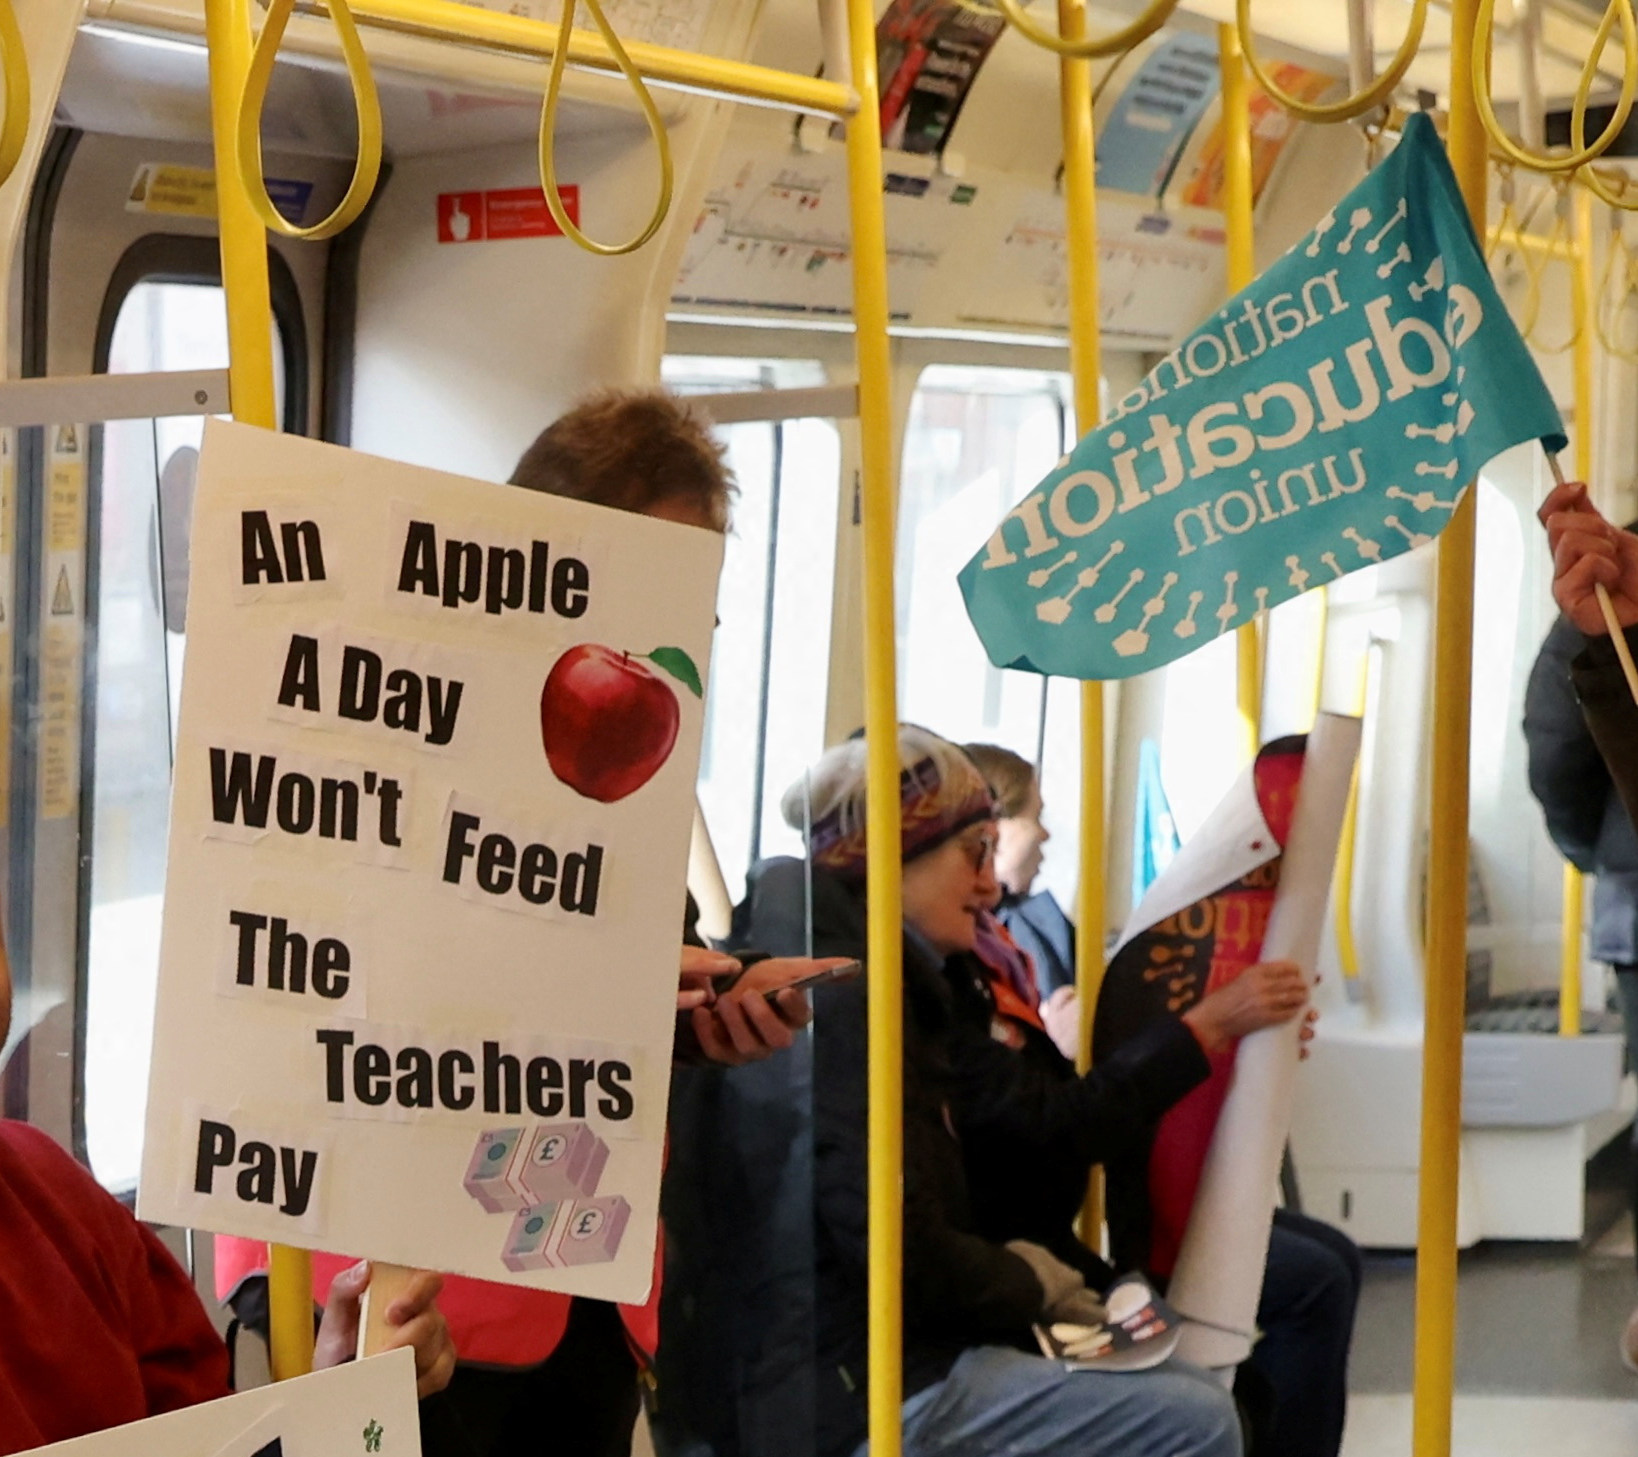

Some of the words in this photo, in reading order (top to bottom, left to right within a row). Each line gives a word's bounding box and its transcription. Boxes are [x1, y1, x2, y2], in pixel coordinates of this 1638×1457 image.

[240, 510, 327, 585] An
[397, 519, 590, 619] Apple
[277, 634, 322, 712] A
[337, 645, 464, 746] Day
[209, 747, 403, 848] Won't
[443, 810, 605, 917] Feed
[229, 910, 352, 1000] The
[316, 1028, 634, 1121] Teachers
[193, 1118, 319, 1217] Pay
